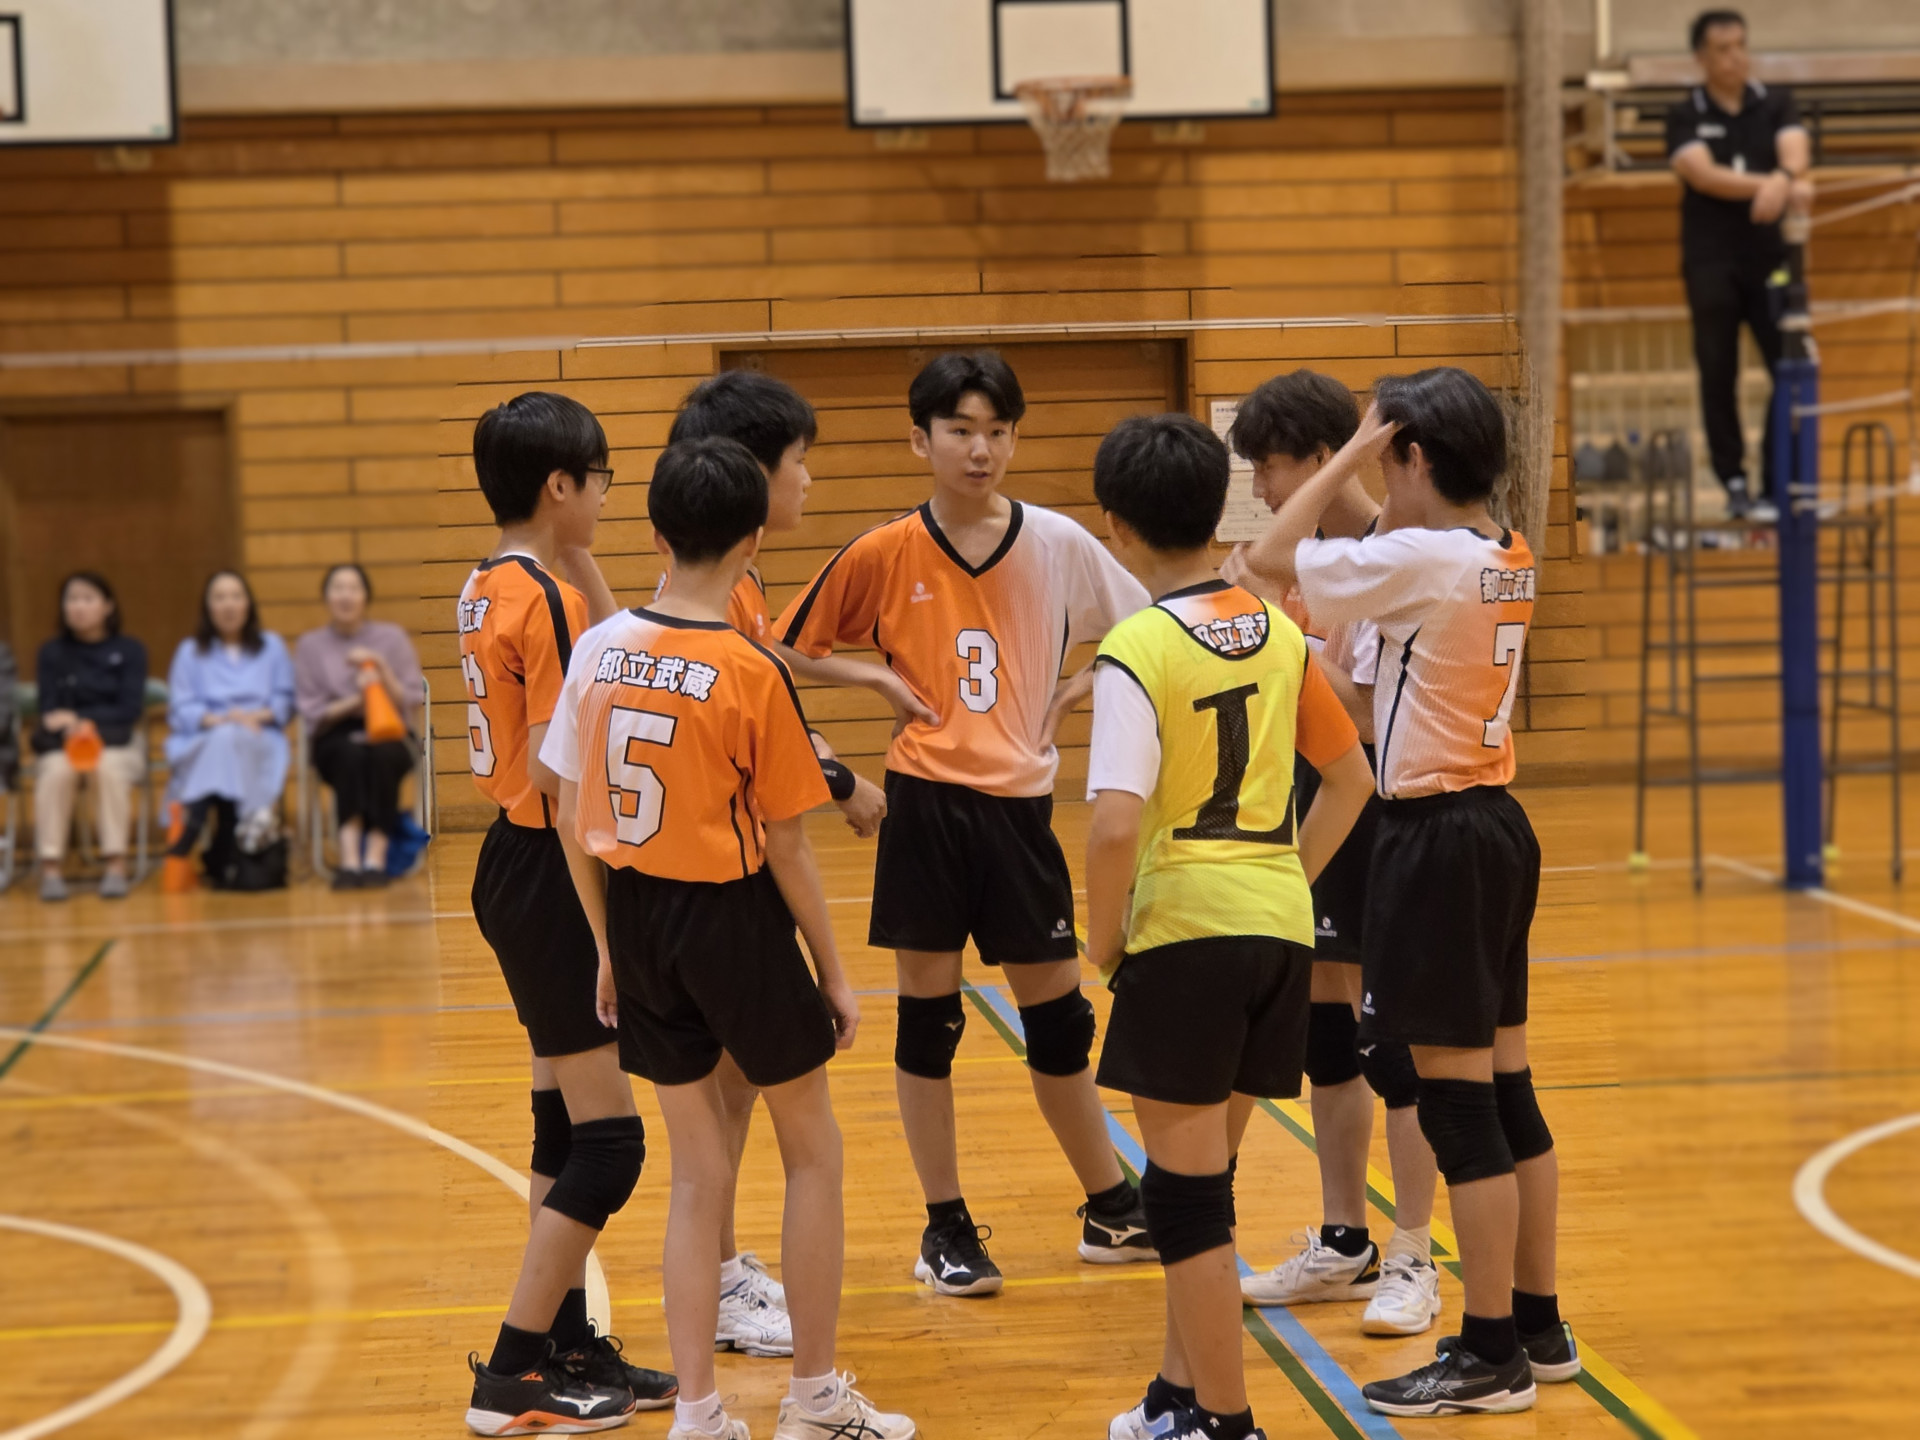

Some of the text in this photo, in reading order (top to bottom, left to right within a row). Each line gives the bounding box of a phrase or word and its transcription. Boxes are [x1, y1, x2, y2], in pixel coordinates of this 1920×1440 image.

[595, 648, 719, 702] 都立武蔵
[956, 628, 998, 714] 3
[1481, 622, 1525, 748] 7
[606, 705, 678, 847] 5
[1172, 682, 1295, 846] L
